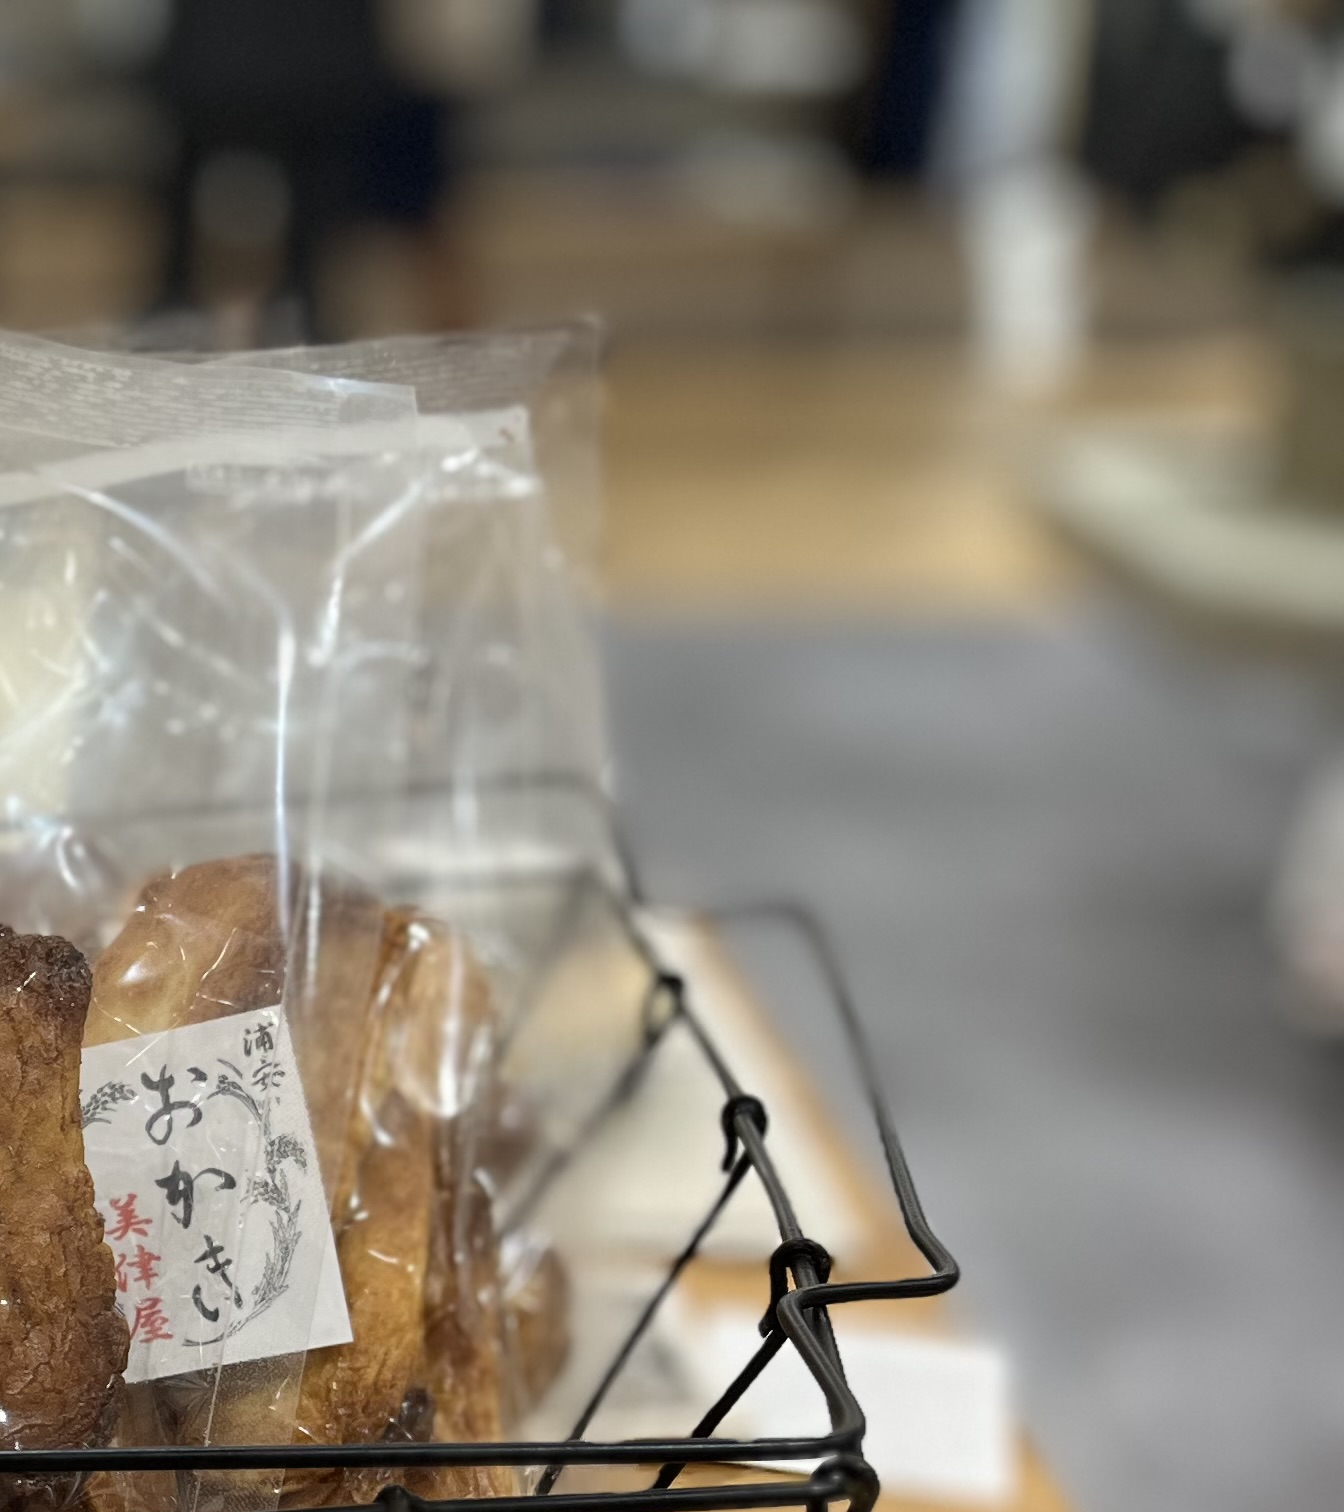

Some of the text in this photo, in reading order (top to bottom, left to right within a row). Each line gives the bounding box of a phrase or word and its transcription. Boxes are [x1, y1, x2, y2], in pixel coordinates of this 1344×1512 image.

[243, 1021, 285, 1092] 浦安
[105, 1192, 174, 1344] 美津屋
[141, 1063, 243, 1322] おかき
